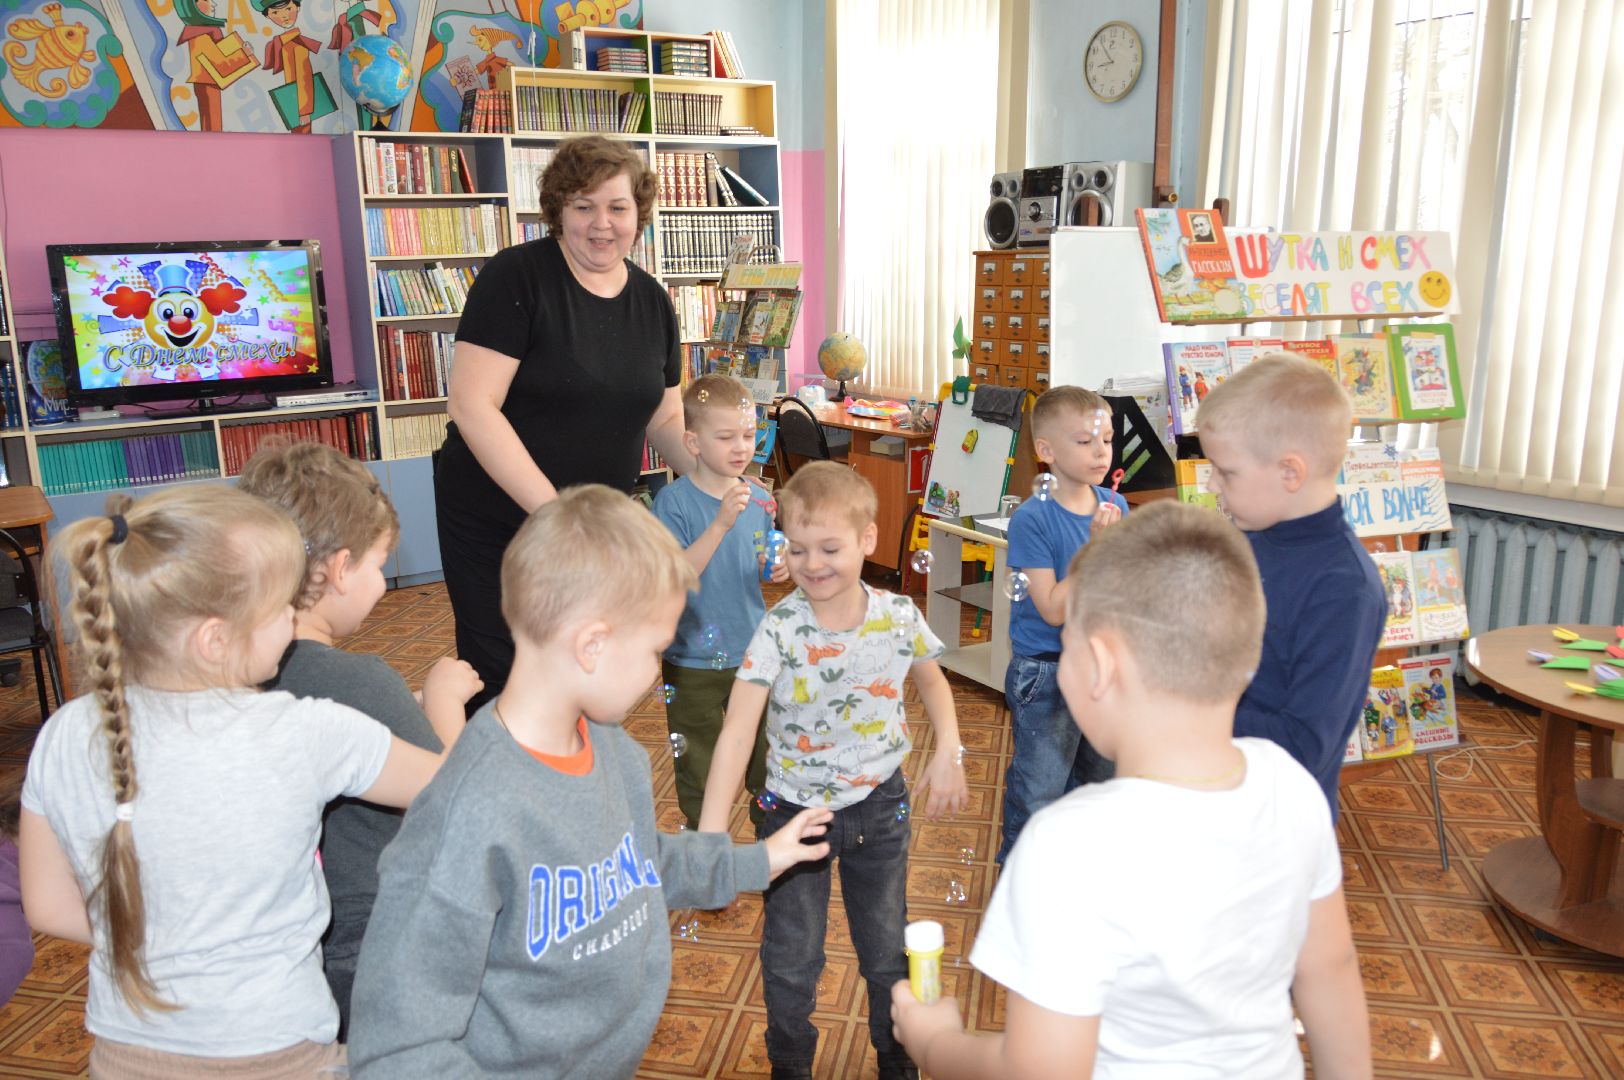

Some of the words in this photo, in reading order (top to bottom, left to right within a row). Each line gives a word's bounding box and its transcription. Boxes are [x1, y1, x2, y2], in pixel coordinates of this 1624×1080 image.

[1235, 233, 1329, 278] ШУТКА
[1360, 235, 1432, 272] СМЕХ
[1236, 281, 1331, 317] ВЕСЕЛЯТ
[1350, 281, 1418, 314] ВСЕХ
[102, 345, 124, 372] С
[130, 343, 209, 367] Днем
[214, 335, 298, 363] смеха!
[1382, 486, 1433, 522] ВОЛНЕ
[1414, 734, 1454, 744] РАССКАЗЫ
